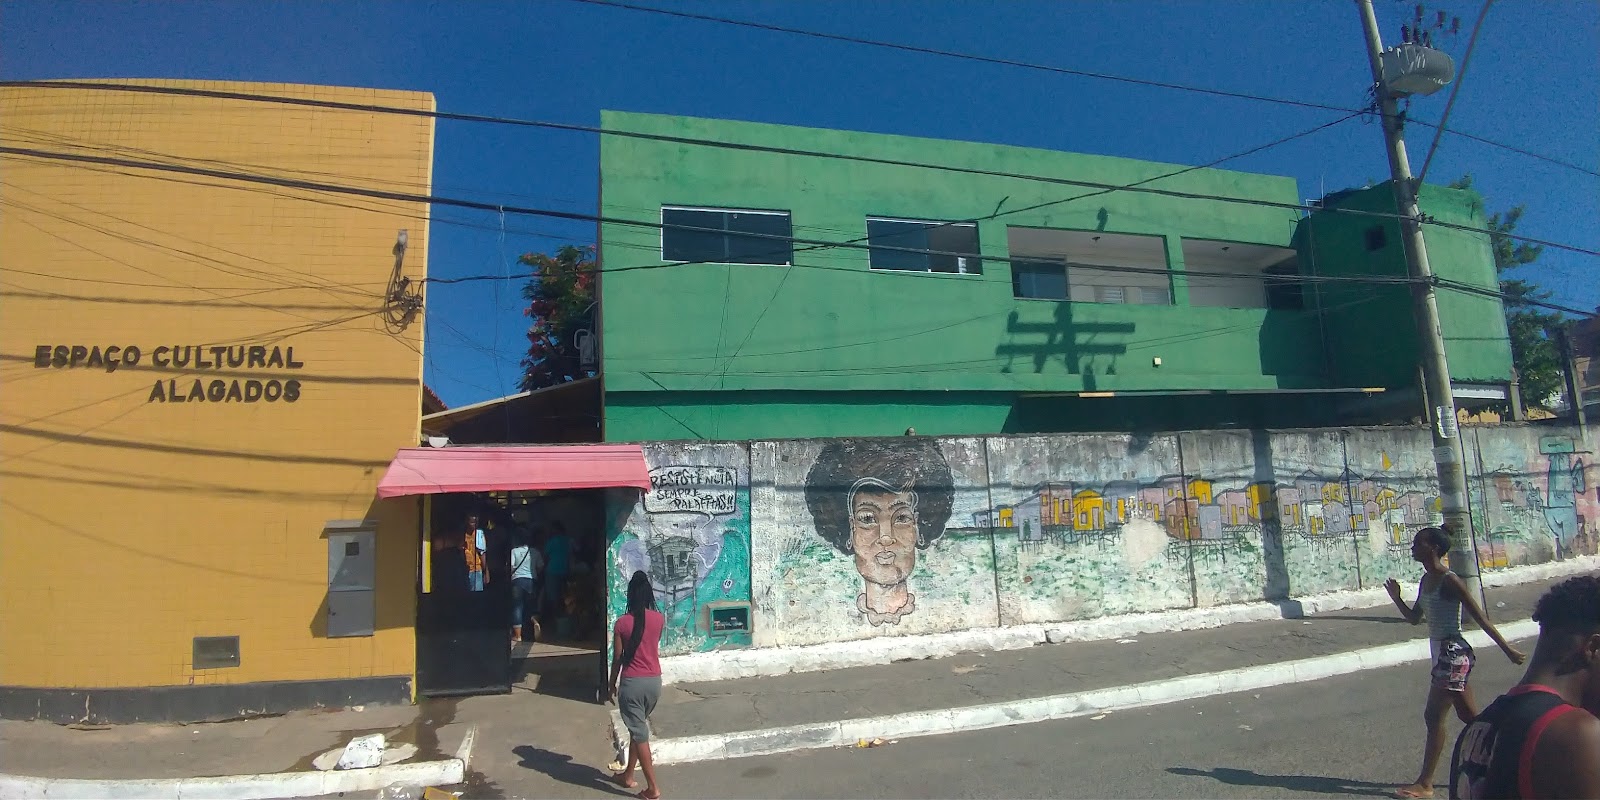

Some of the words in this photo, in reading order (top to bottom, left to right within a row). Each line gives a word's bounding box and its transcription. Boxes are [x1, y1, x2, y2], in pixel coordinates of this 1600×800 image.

[34, 345, 142, 373] ESPAÇO
[152, 345, 304, 370] CULTURAL
[148, 379, 302, 403] ALAGADOS
[656, 487, 701, 501] SEMPRE
